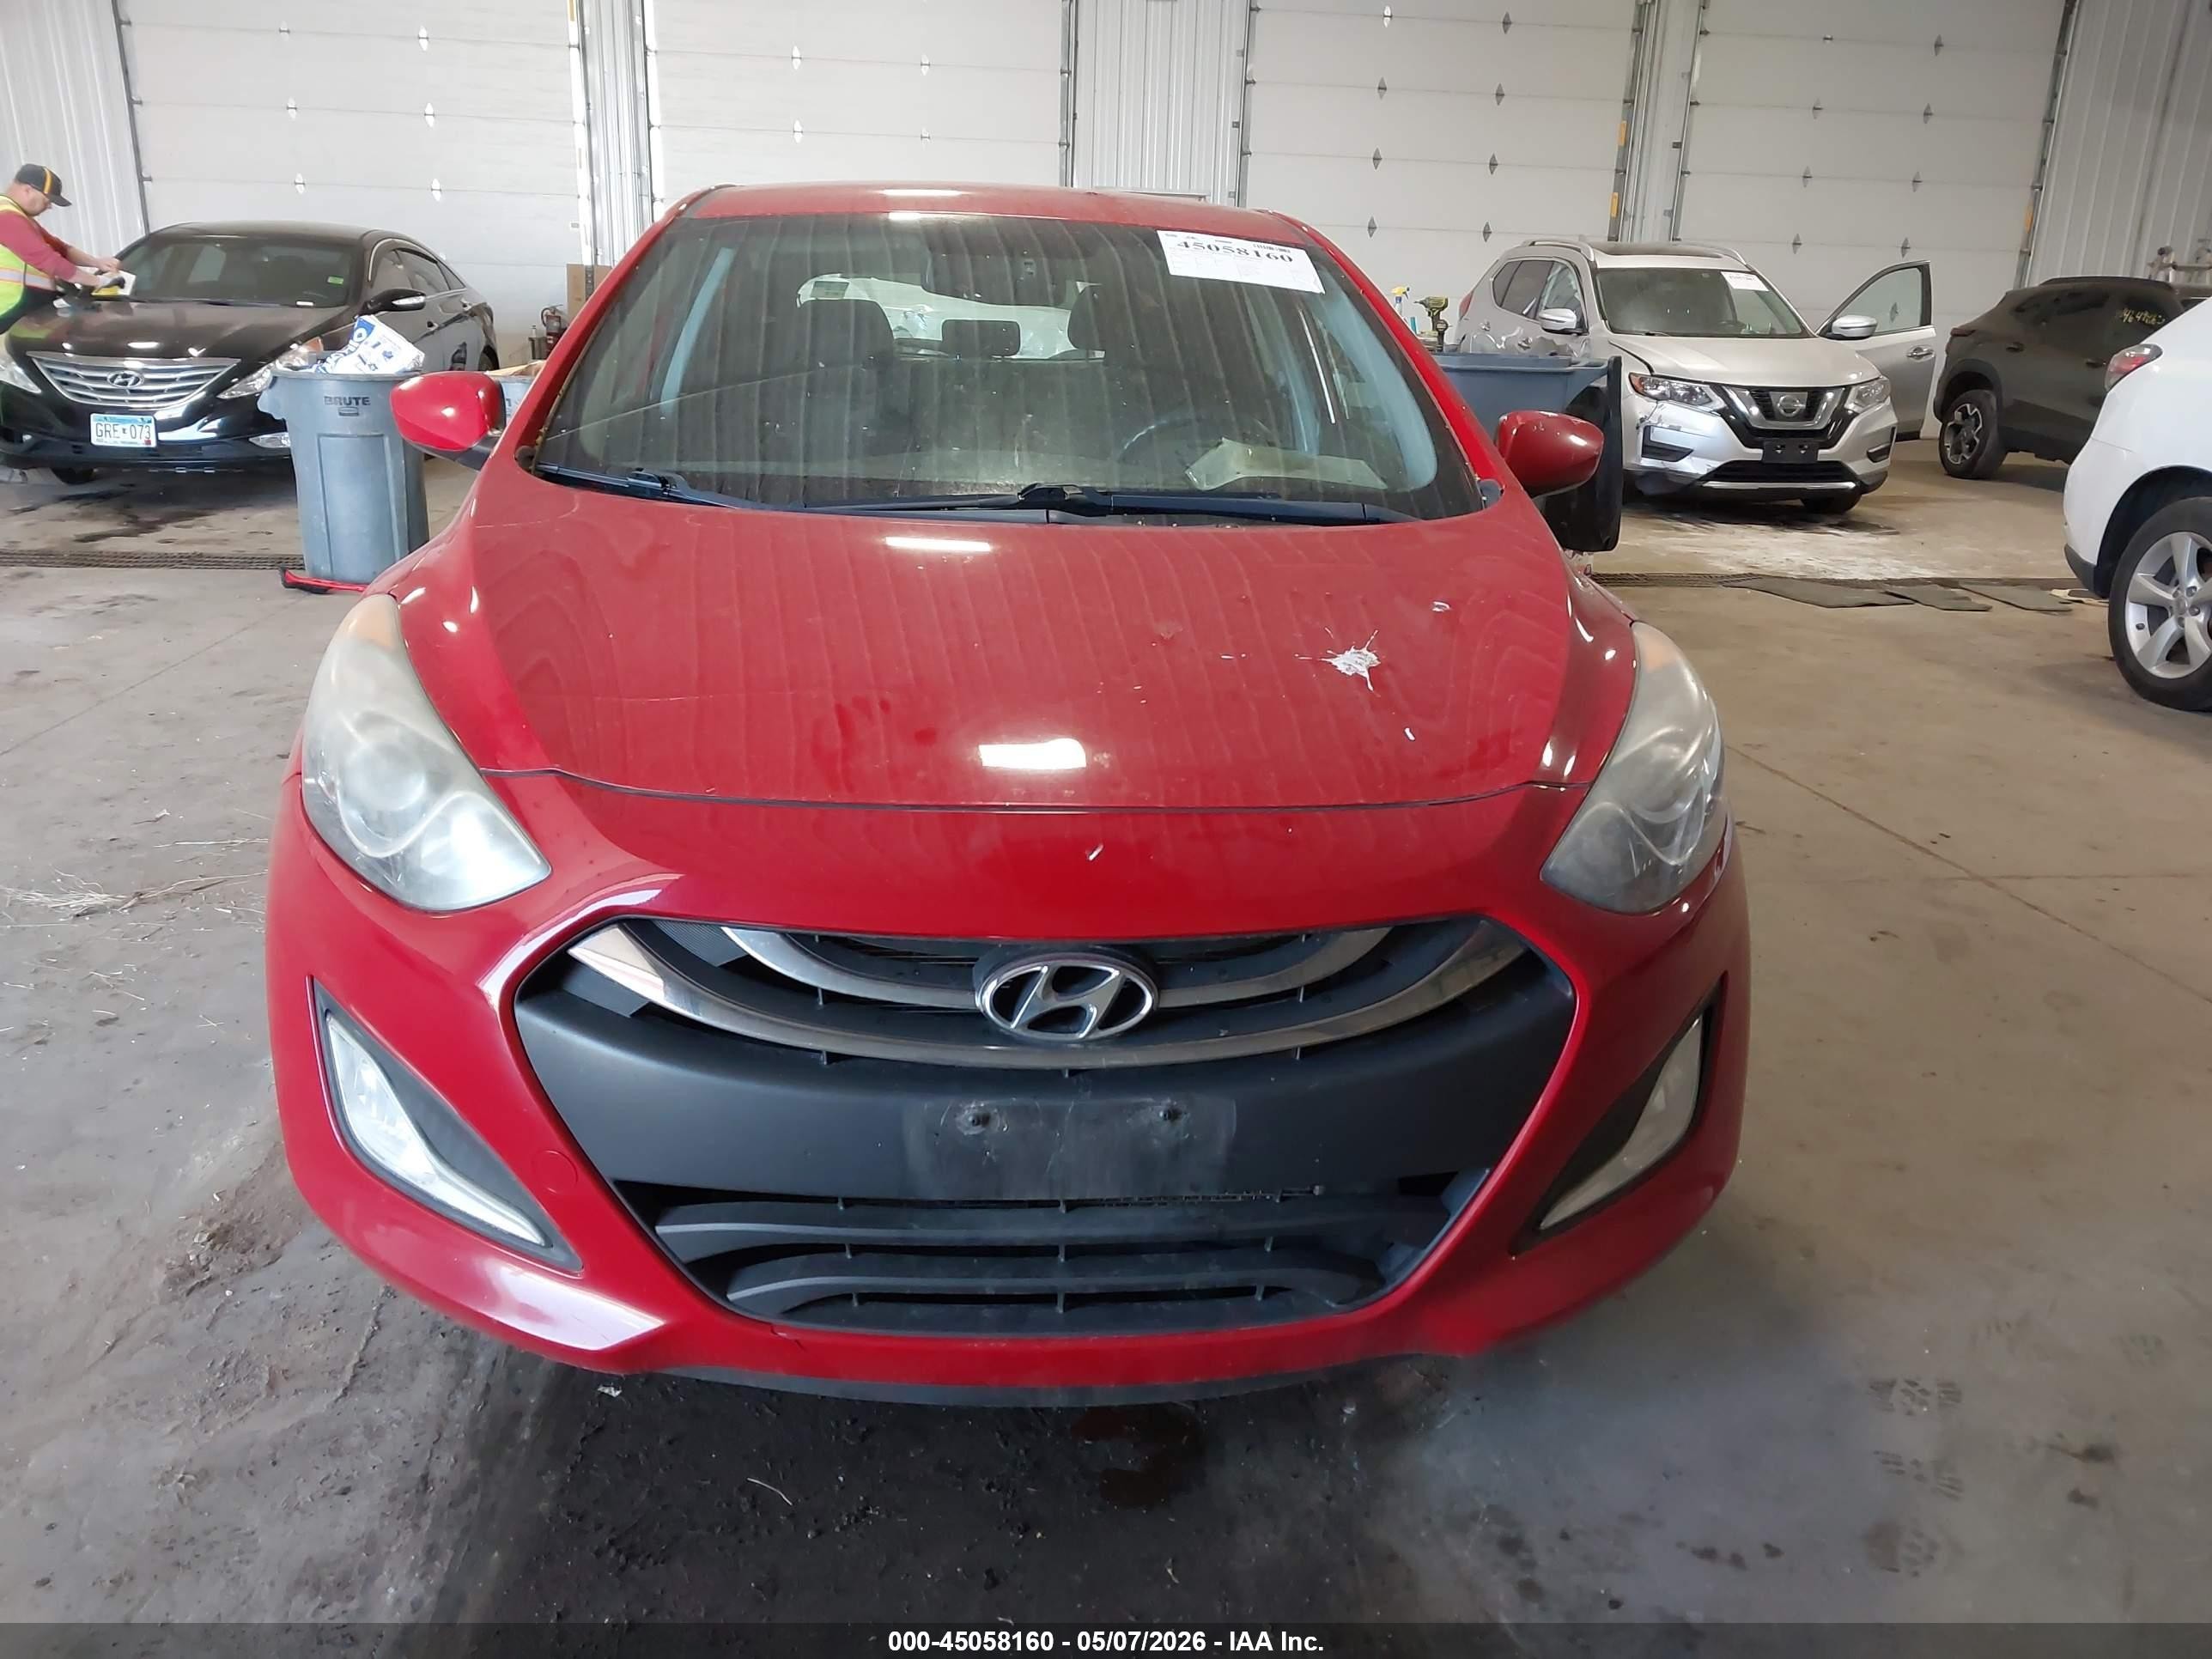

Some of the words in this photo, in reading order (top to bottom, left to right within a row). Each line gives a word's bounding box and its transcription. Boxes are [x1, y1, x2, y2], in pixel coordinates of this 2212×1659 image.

[1176, 240, 1294, 263] 45058160
[324, 395, 371, 406] BRUTE
[95, 422, 120, 439] GRE
[130, 424, 151, 440] 073
